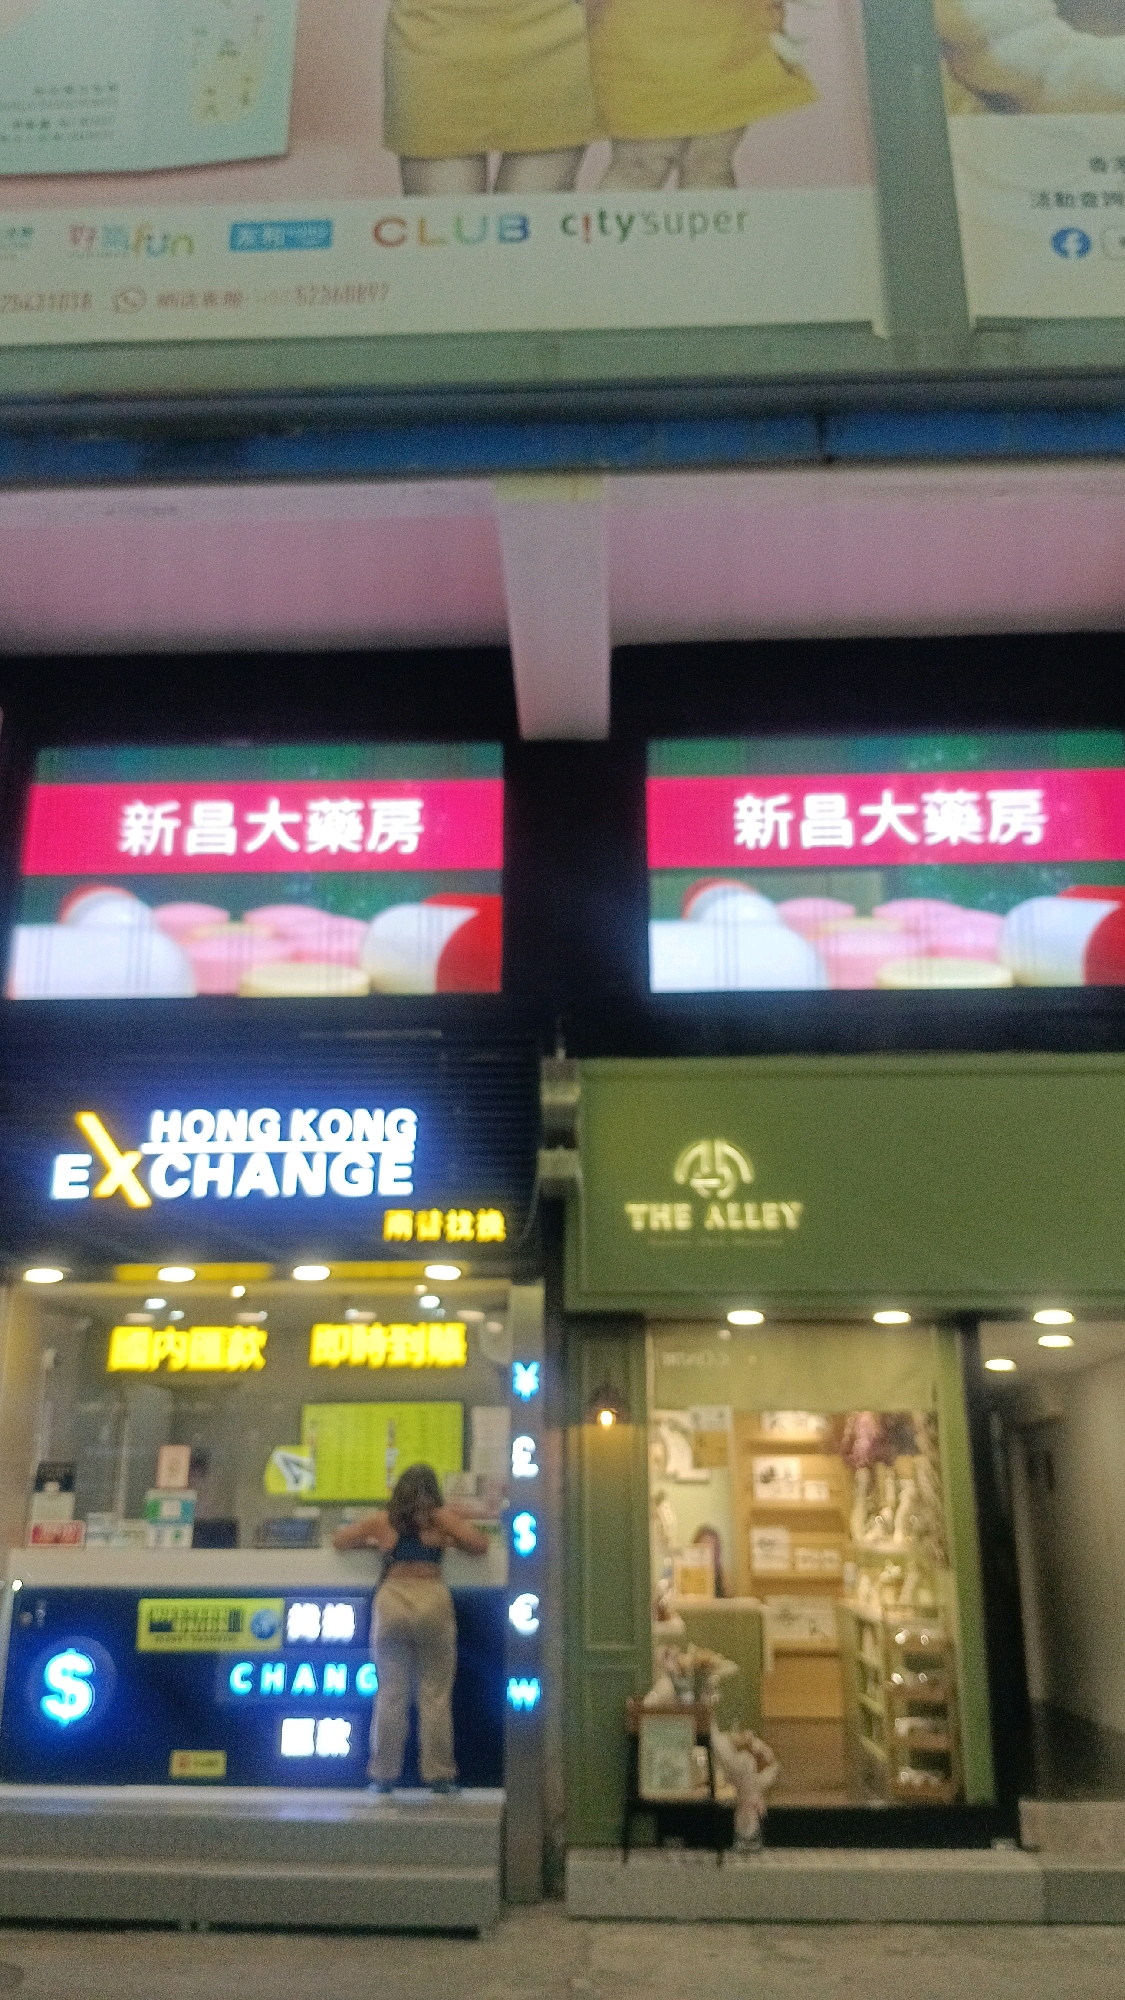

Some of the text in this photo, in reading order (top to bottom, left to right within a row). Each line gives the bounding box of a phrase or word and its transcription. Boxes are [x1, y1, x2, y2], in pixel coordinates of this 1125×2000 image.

[373, 214, 530, 248] CLUB
[118, 797, 425, 856] 新昌大藥房
[733, 788, 1048, 850] 新昌大藥房
[150, 1108, 417, 1142] HONG KONG
[51, 1111, 415, 1208] EXCHANGE
[625, 1202, 804, 1231] THE ALLEY
[40, 1648, 96, 1726] $
[229, 1661, 379, 1697] CHANG
